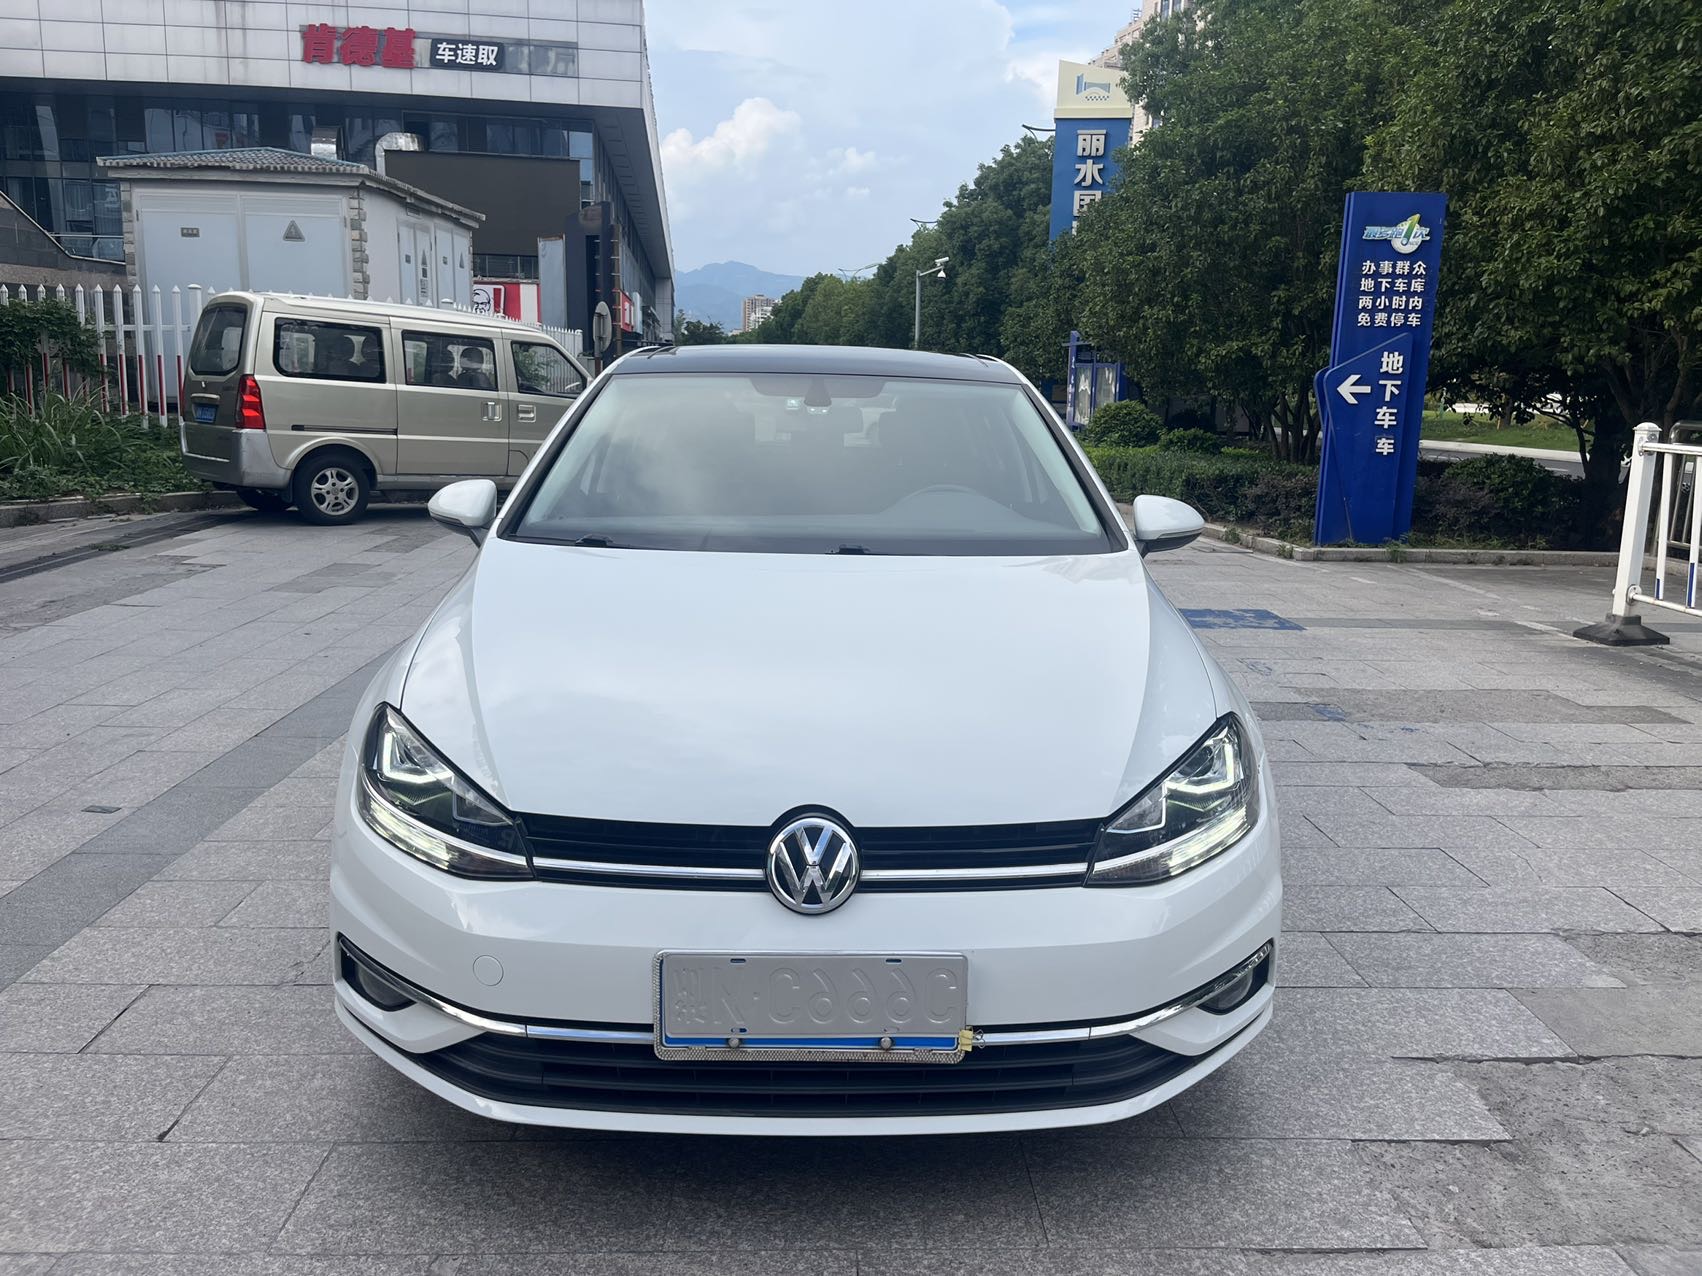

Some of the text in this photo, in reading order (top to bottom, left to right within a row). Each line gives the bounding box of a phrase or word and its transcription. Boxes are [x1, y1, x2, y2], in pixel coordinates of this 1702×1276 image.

[302, 22, 416, 69] 肯德基
[435, 41, 499, 66] 车速取
[1072, 129, 1107, 236] 丽水国
[1361, 260, 1427, 275] 办事群众
[1359, 278, 1426, 292] 地下车库
[1358, 295, 1423, 310] 两小时内
[1357, 312, 1422, 327] 免费停车
